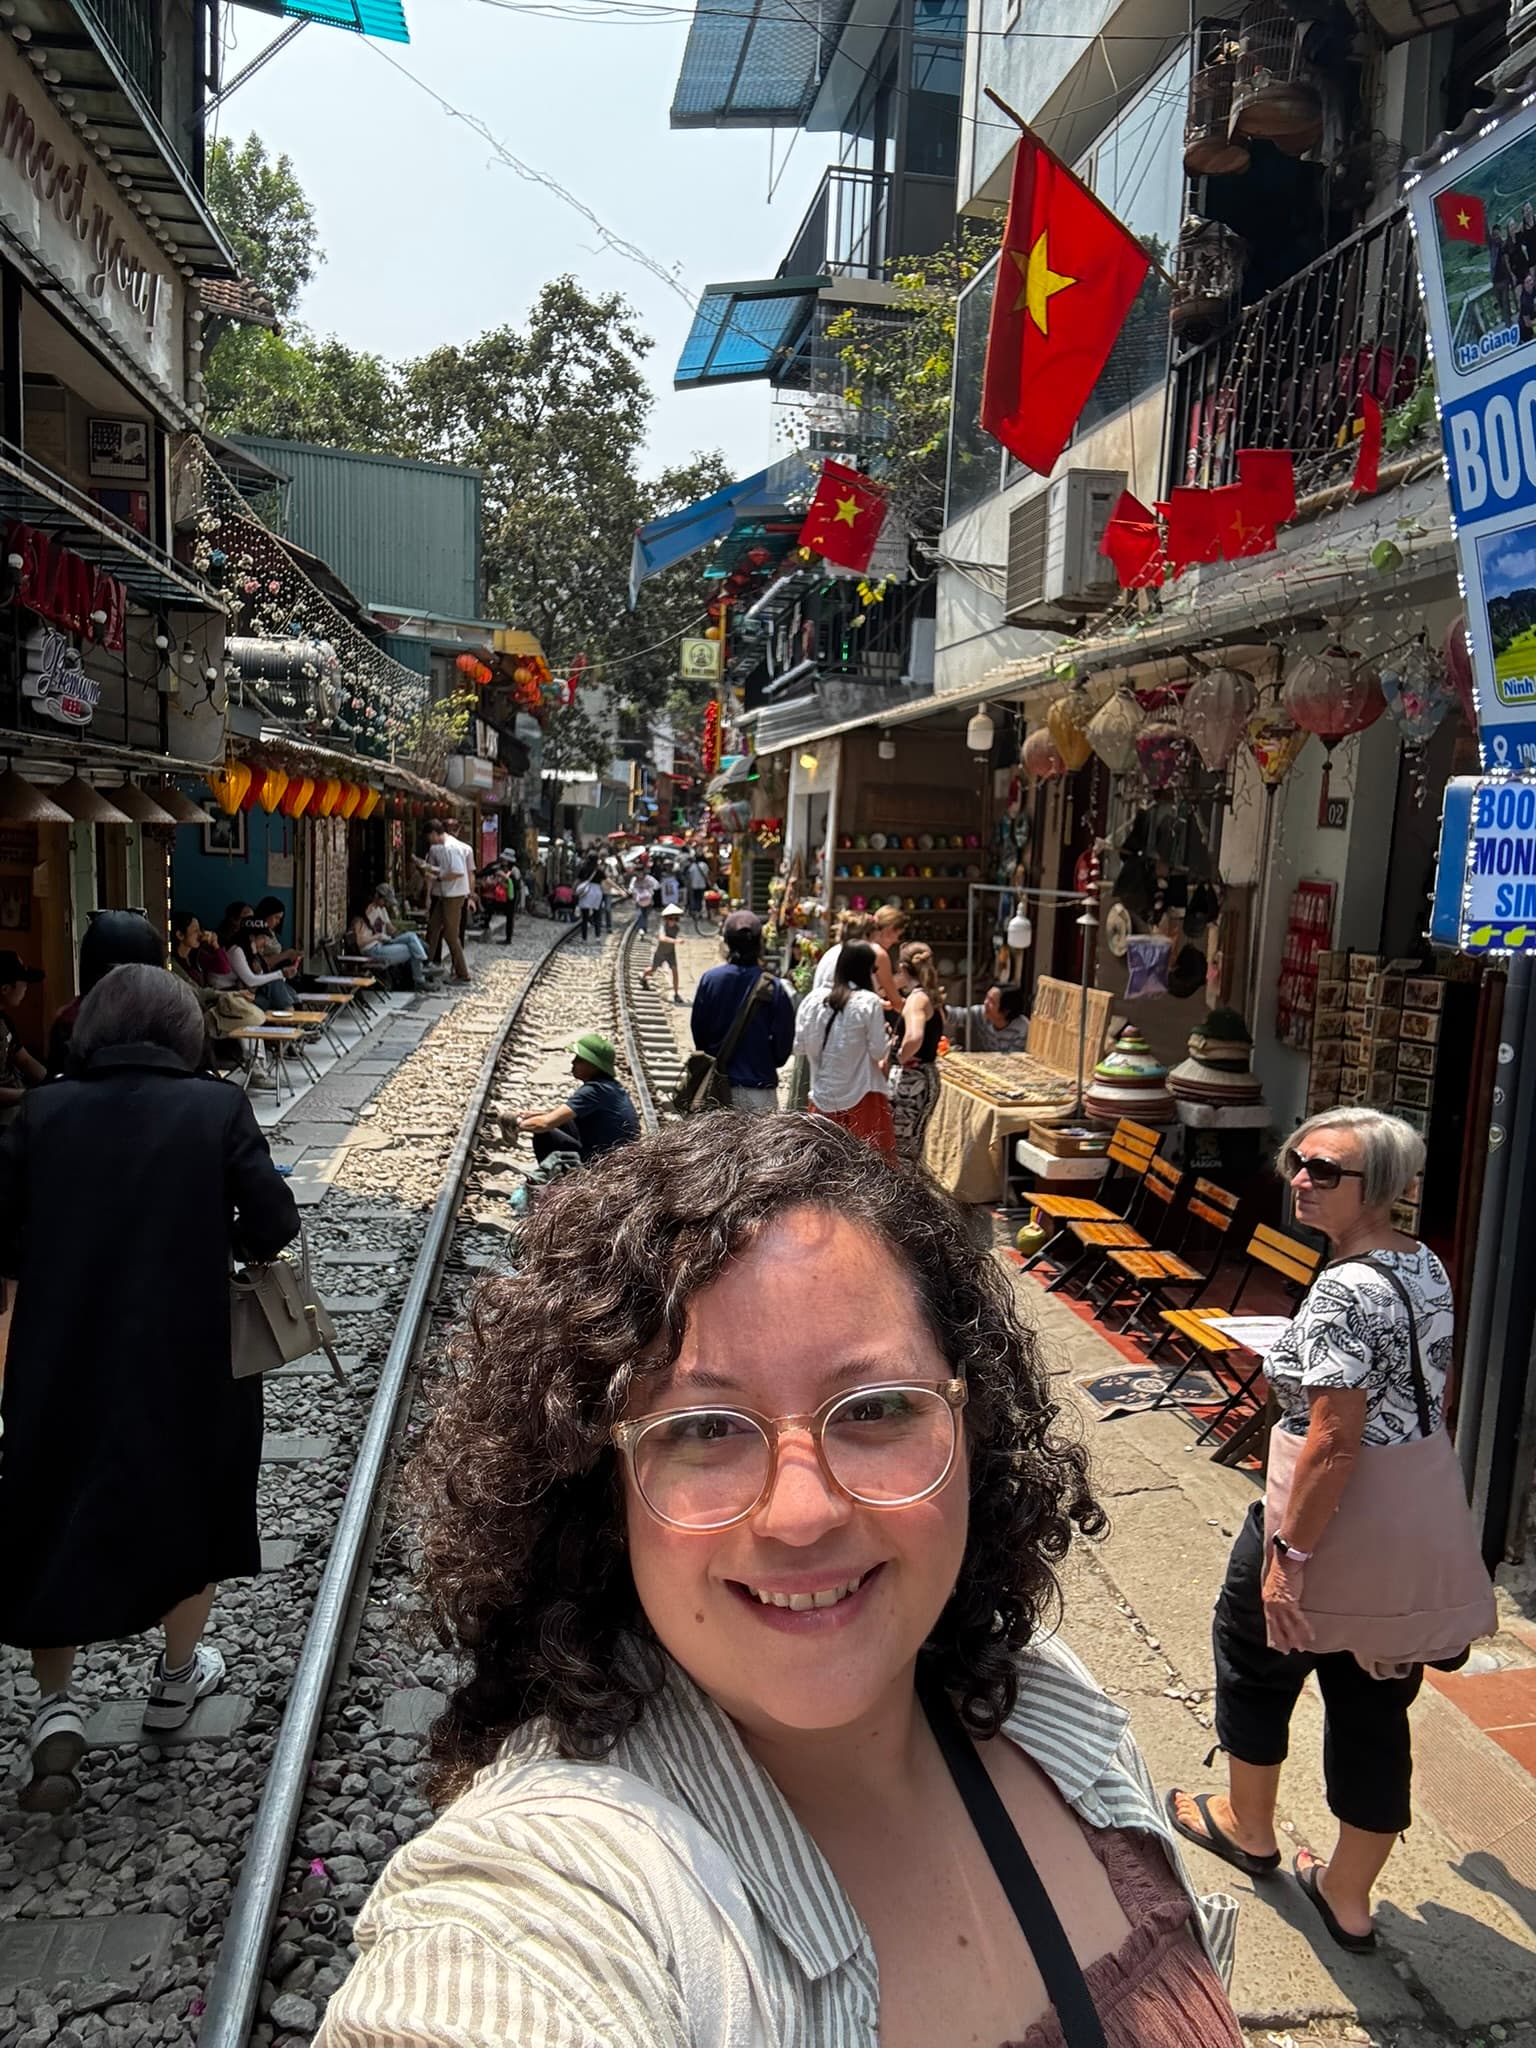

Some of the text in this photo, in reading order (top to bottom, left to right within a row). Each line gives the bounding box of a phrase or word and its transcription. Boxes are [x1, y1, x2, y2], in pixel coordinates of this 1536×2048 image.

[1460, 326, 1519, 367] Ha Giang
[1503, 677, 1535, 697] Ninh
[1329, 804, 1344, 824] 02
[1476, 789, 1536, 830] BOO
[1472, 837, 1536, 875] MON
